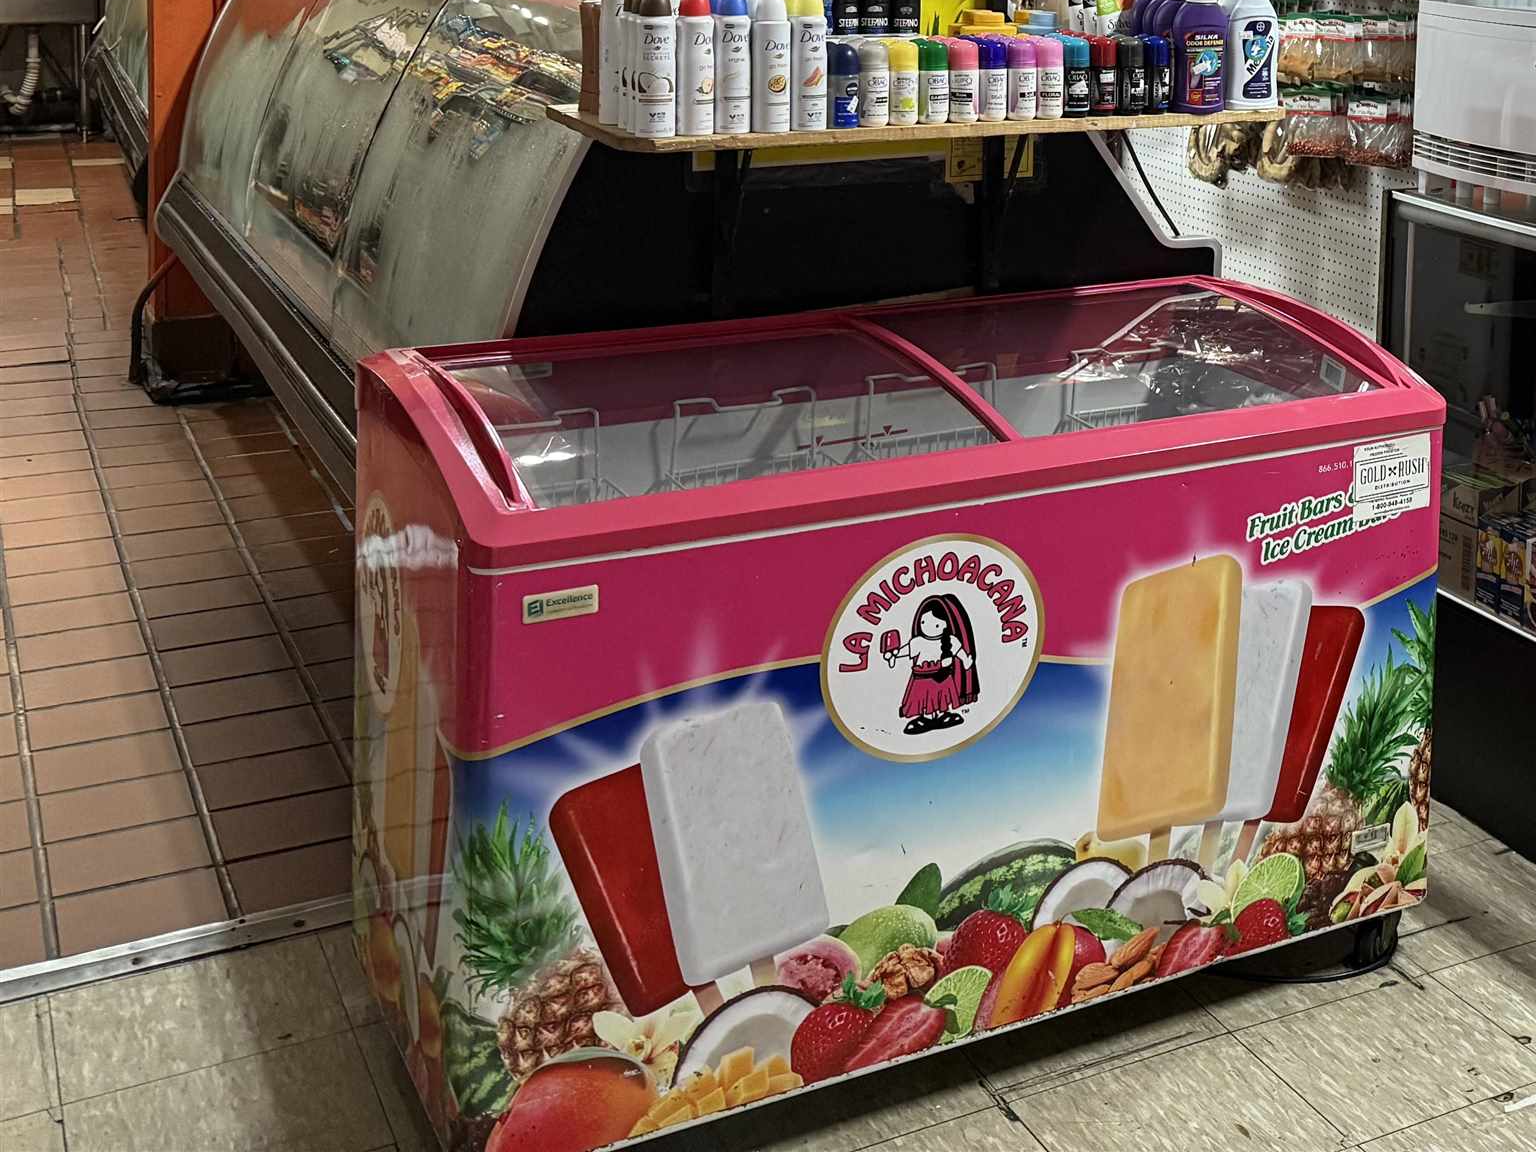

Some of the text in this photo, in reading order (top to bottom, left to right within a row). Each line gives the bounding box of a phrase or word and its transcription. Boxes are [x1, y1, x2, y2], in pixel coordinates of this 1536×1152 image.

[861, 17, 889, 26] STEFANO
[894, 18, 918, 27] STEFANO
[643, 32, 670, 45] Dove
[722, 30, 749, 43] Dove
[800, 30, 824, 43] Dove
[1360, 457, 1426, 485] GOLD RUSH
[1374, 479, 1411, 491] DISTRIBUTION
[1249, 508, 1297, 538] Fruit
[1301, 493, 1343, 521] Bars
[1263, 539, 1290, 563] Ice
[1294, 517, 1354, 551] Cream
[546, 592, 594, 607] Excellence
[838, 551, 1028, 674] LA MICHOACANA
